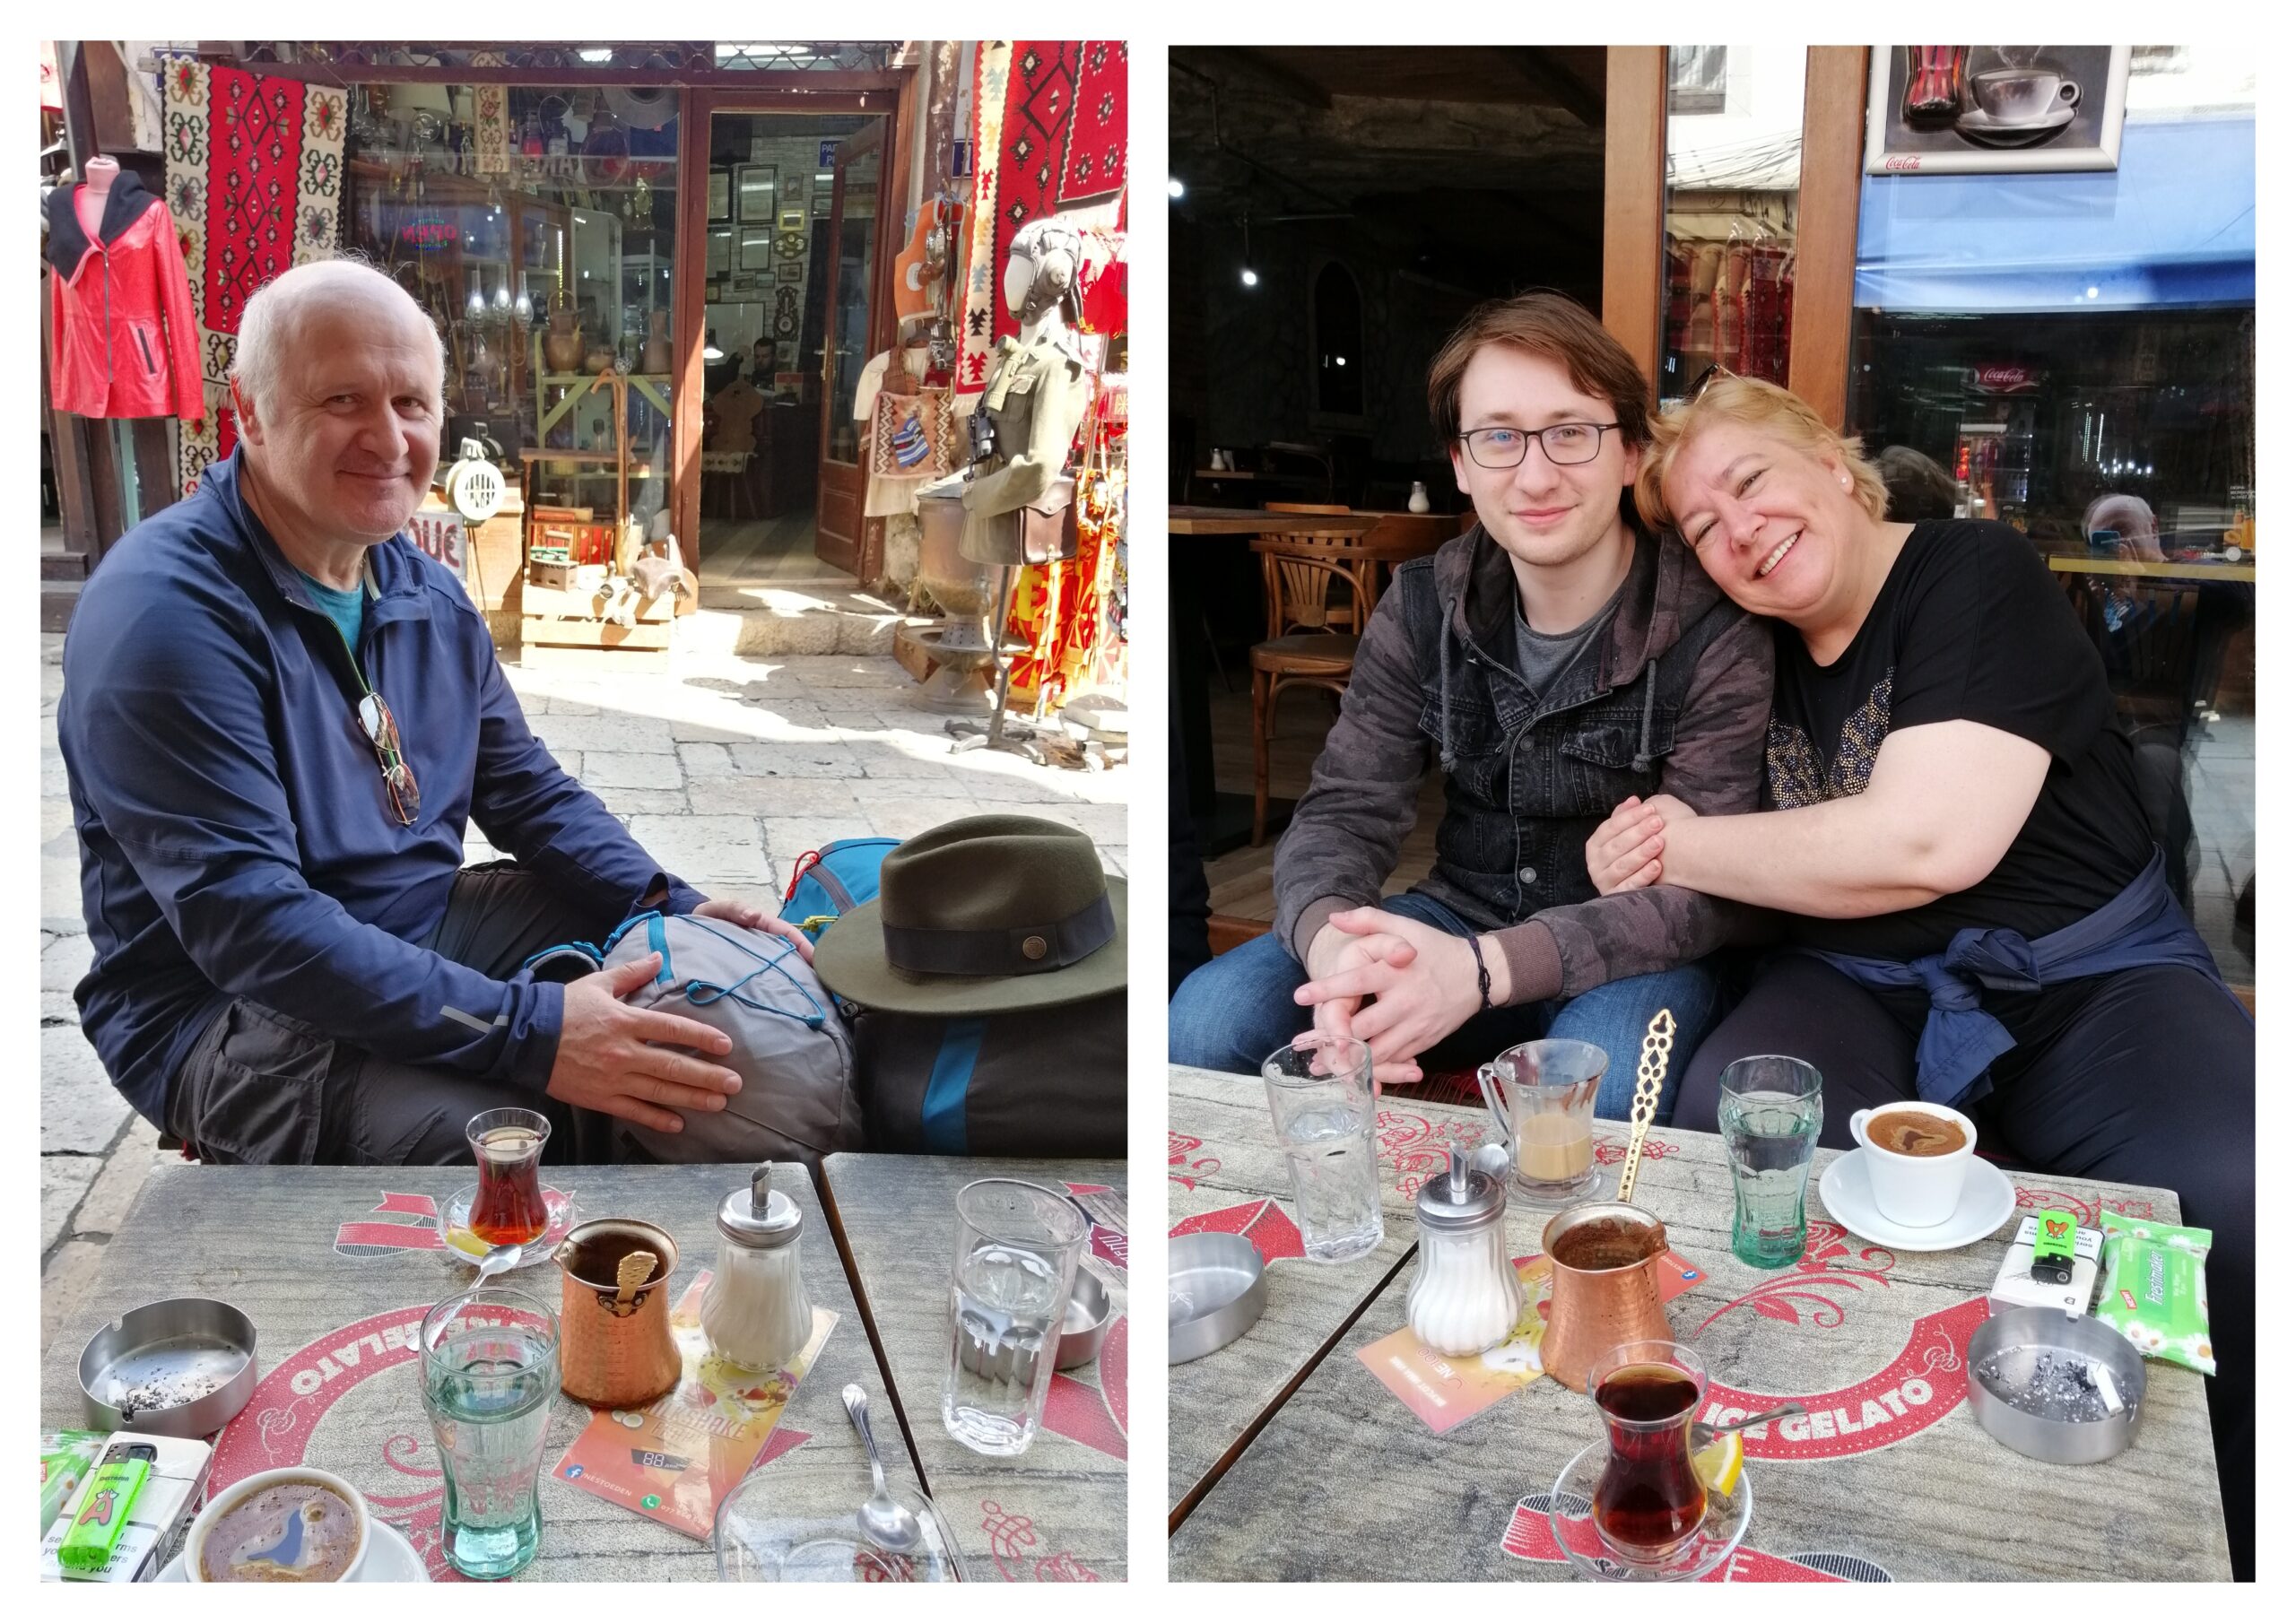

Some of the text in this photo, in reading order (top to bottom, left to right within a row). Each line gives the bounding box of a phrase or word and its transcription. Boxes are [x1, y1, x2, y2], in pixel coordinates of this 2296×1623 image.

[2144, 1250, 2164, 1306] Freshmaker
[1701, 1379, 1933, 1441] ICE GELATO
